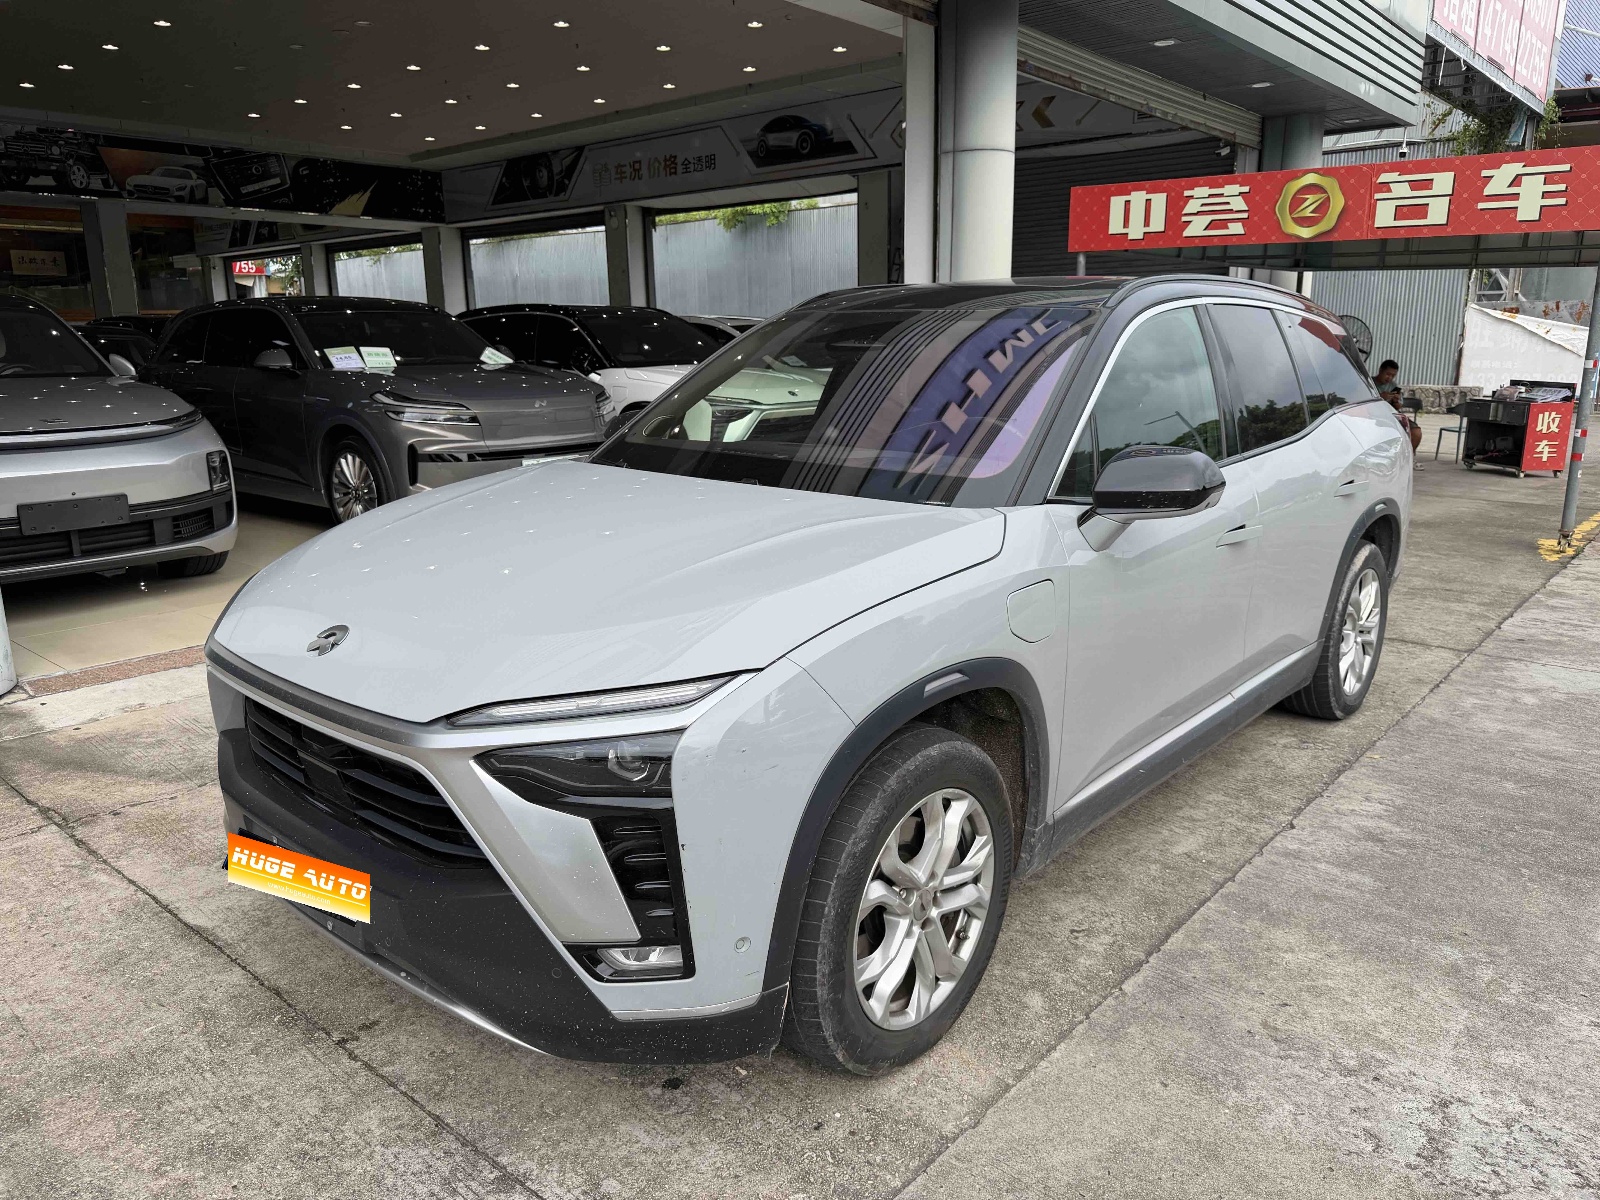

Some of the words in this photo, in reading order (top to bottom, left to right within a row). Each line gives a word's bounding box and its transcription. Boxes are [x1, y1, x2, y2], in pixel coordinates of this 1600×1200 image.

[613, 159, 643, 183] 车况
[647, 154, 678, 178] 价格
[680, 153, 717, 175] 全透明
[1374, 162, 1571, 228] 名车
[1108, 184, 1250, 240] 中荟
[1533, 410, 1563, 462] 收车
